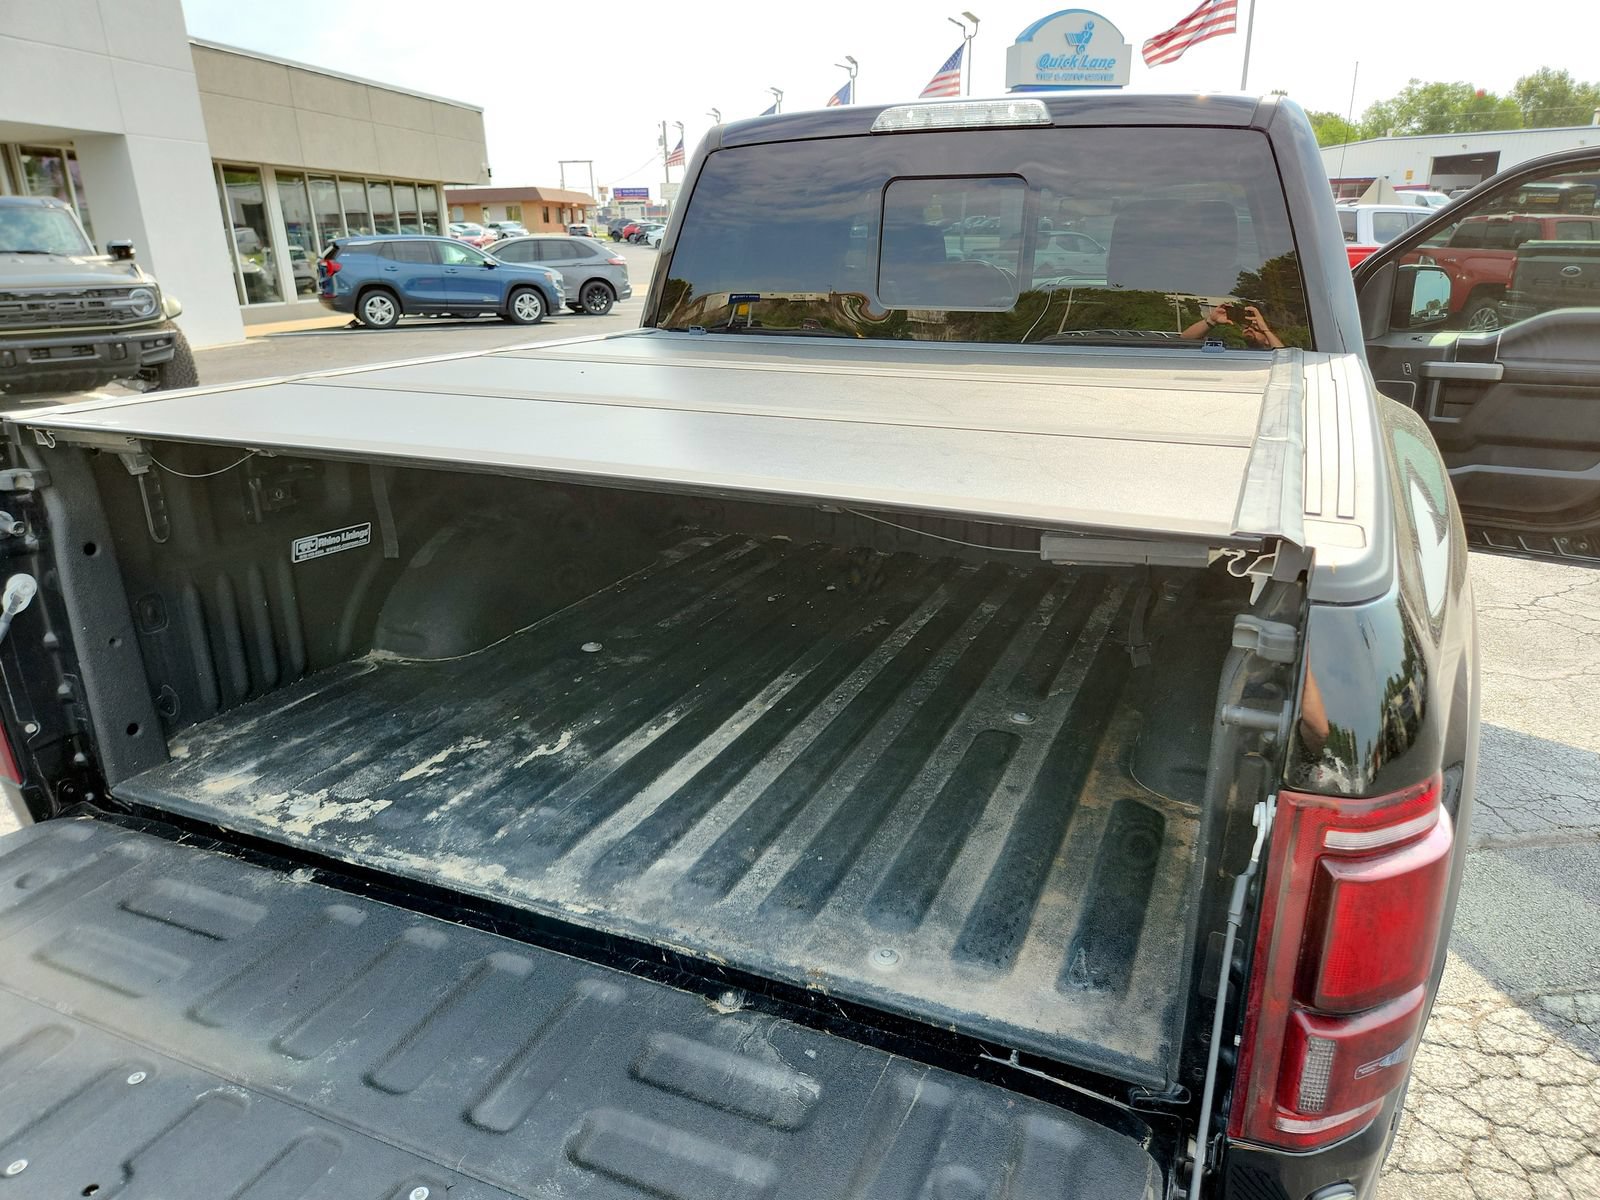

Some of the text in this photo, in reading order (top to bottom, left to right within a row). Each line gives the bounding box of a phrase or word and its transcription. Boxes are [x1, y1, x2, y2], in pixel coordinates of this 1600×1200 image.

[1038, 53, 1116, 71] Quick Lane
[319, 529, 369, 548] Rhino Linings
